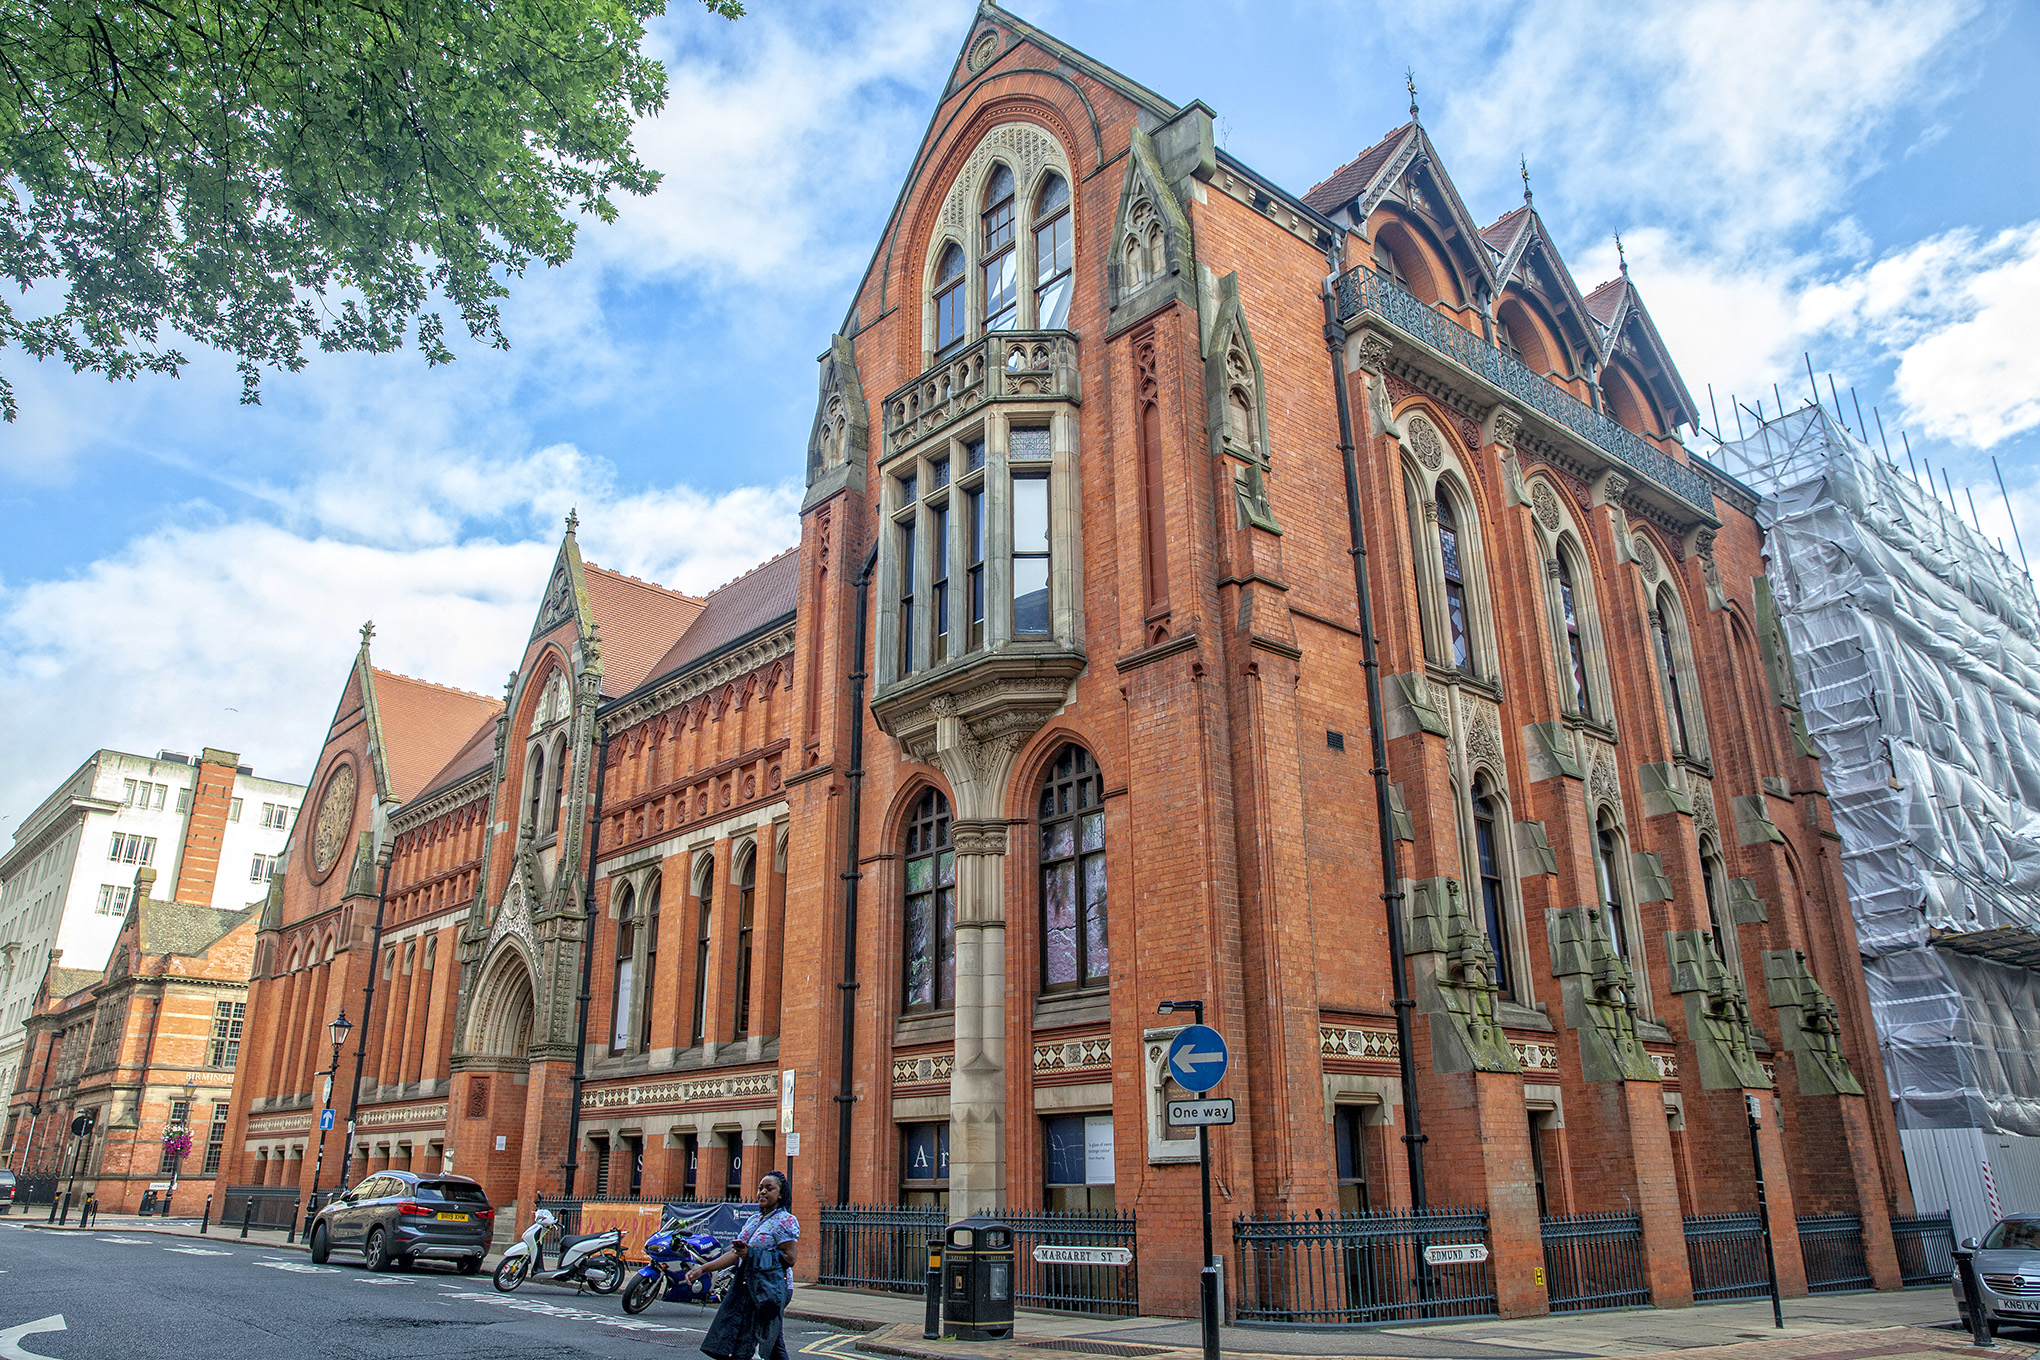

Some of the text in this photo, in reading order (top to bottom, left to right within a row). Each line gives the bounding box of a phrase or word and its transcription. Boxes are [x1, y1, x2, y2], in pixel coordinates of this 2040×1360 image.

[1173, 1107, 1228, 1118] One way
[1041, 1250, 1091, 1261] MARGARET
[1101, 1252, 1113, 1262] ST
[1431, 1250, 1463, 1261] EDMUND
[1470, 1248, 1479, 1259] ST
[2004, 1300, 2025, 1310] KN61
